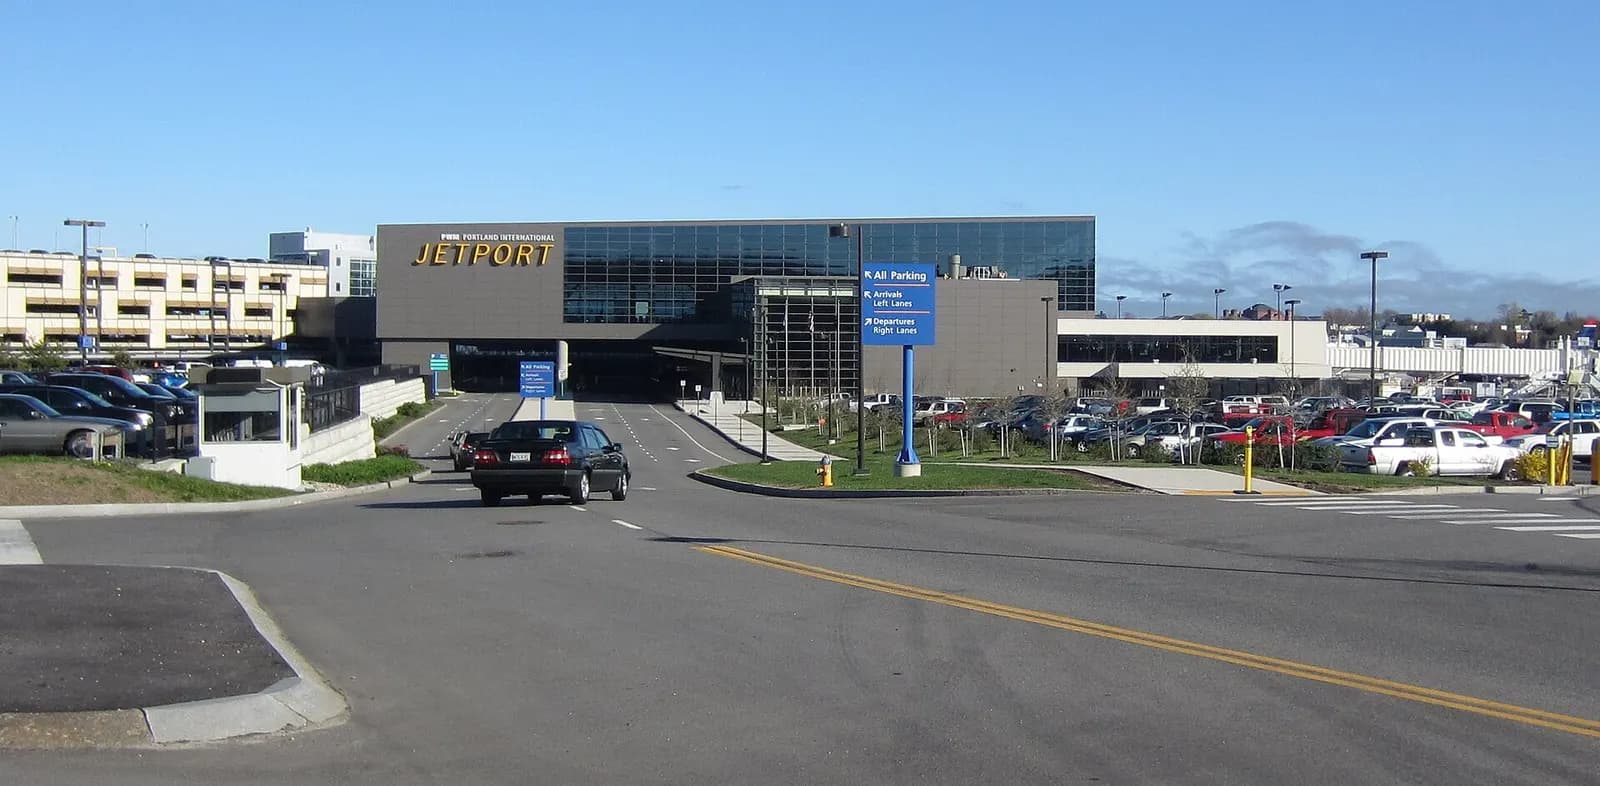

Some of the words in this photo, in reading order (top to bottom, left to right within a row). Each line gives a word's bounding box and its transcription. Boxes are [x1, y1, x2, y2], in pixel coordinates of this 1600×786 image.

[414, 243, 554, 265] JETPORT
[874, 270, 886, 280] All
[891, 271, 926, 282] Parking
[874, 327, 893, 335] Right
